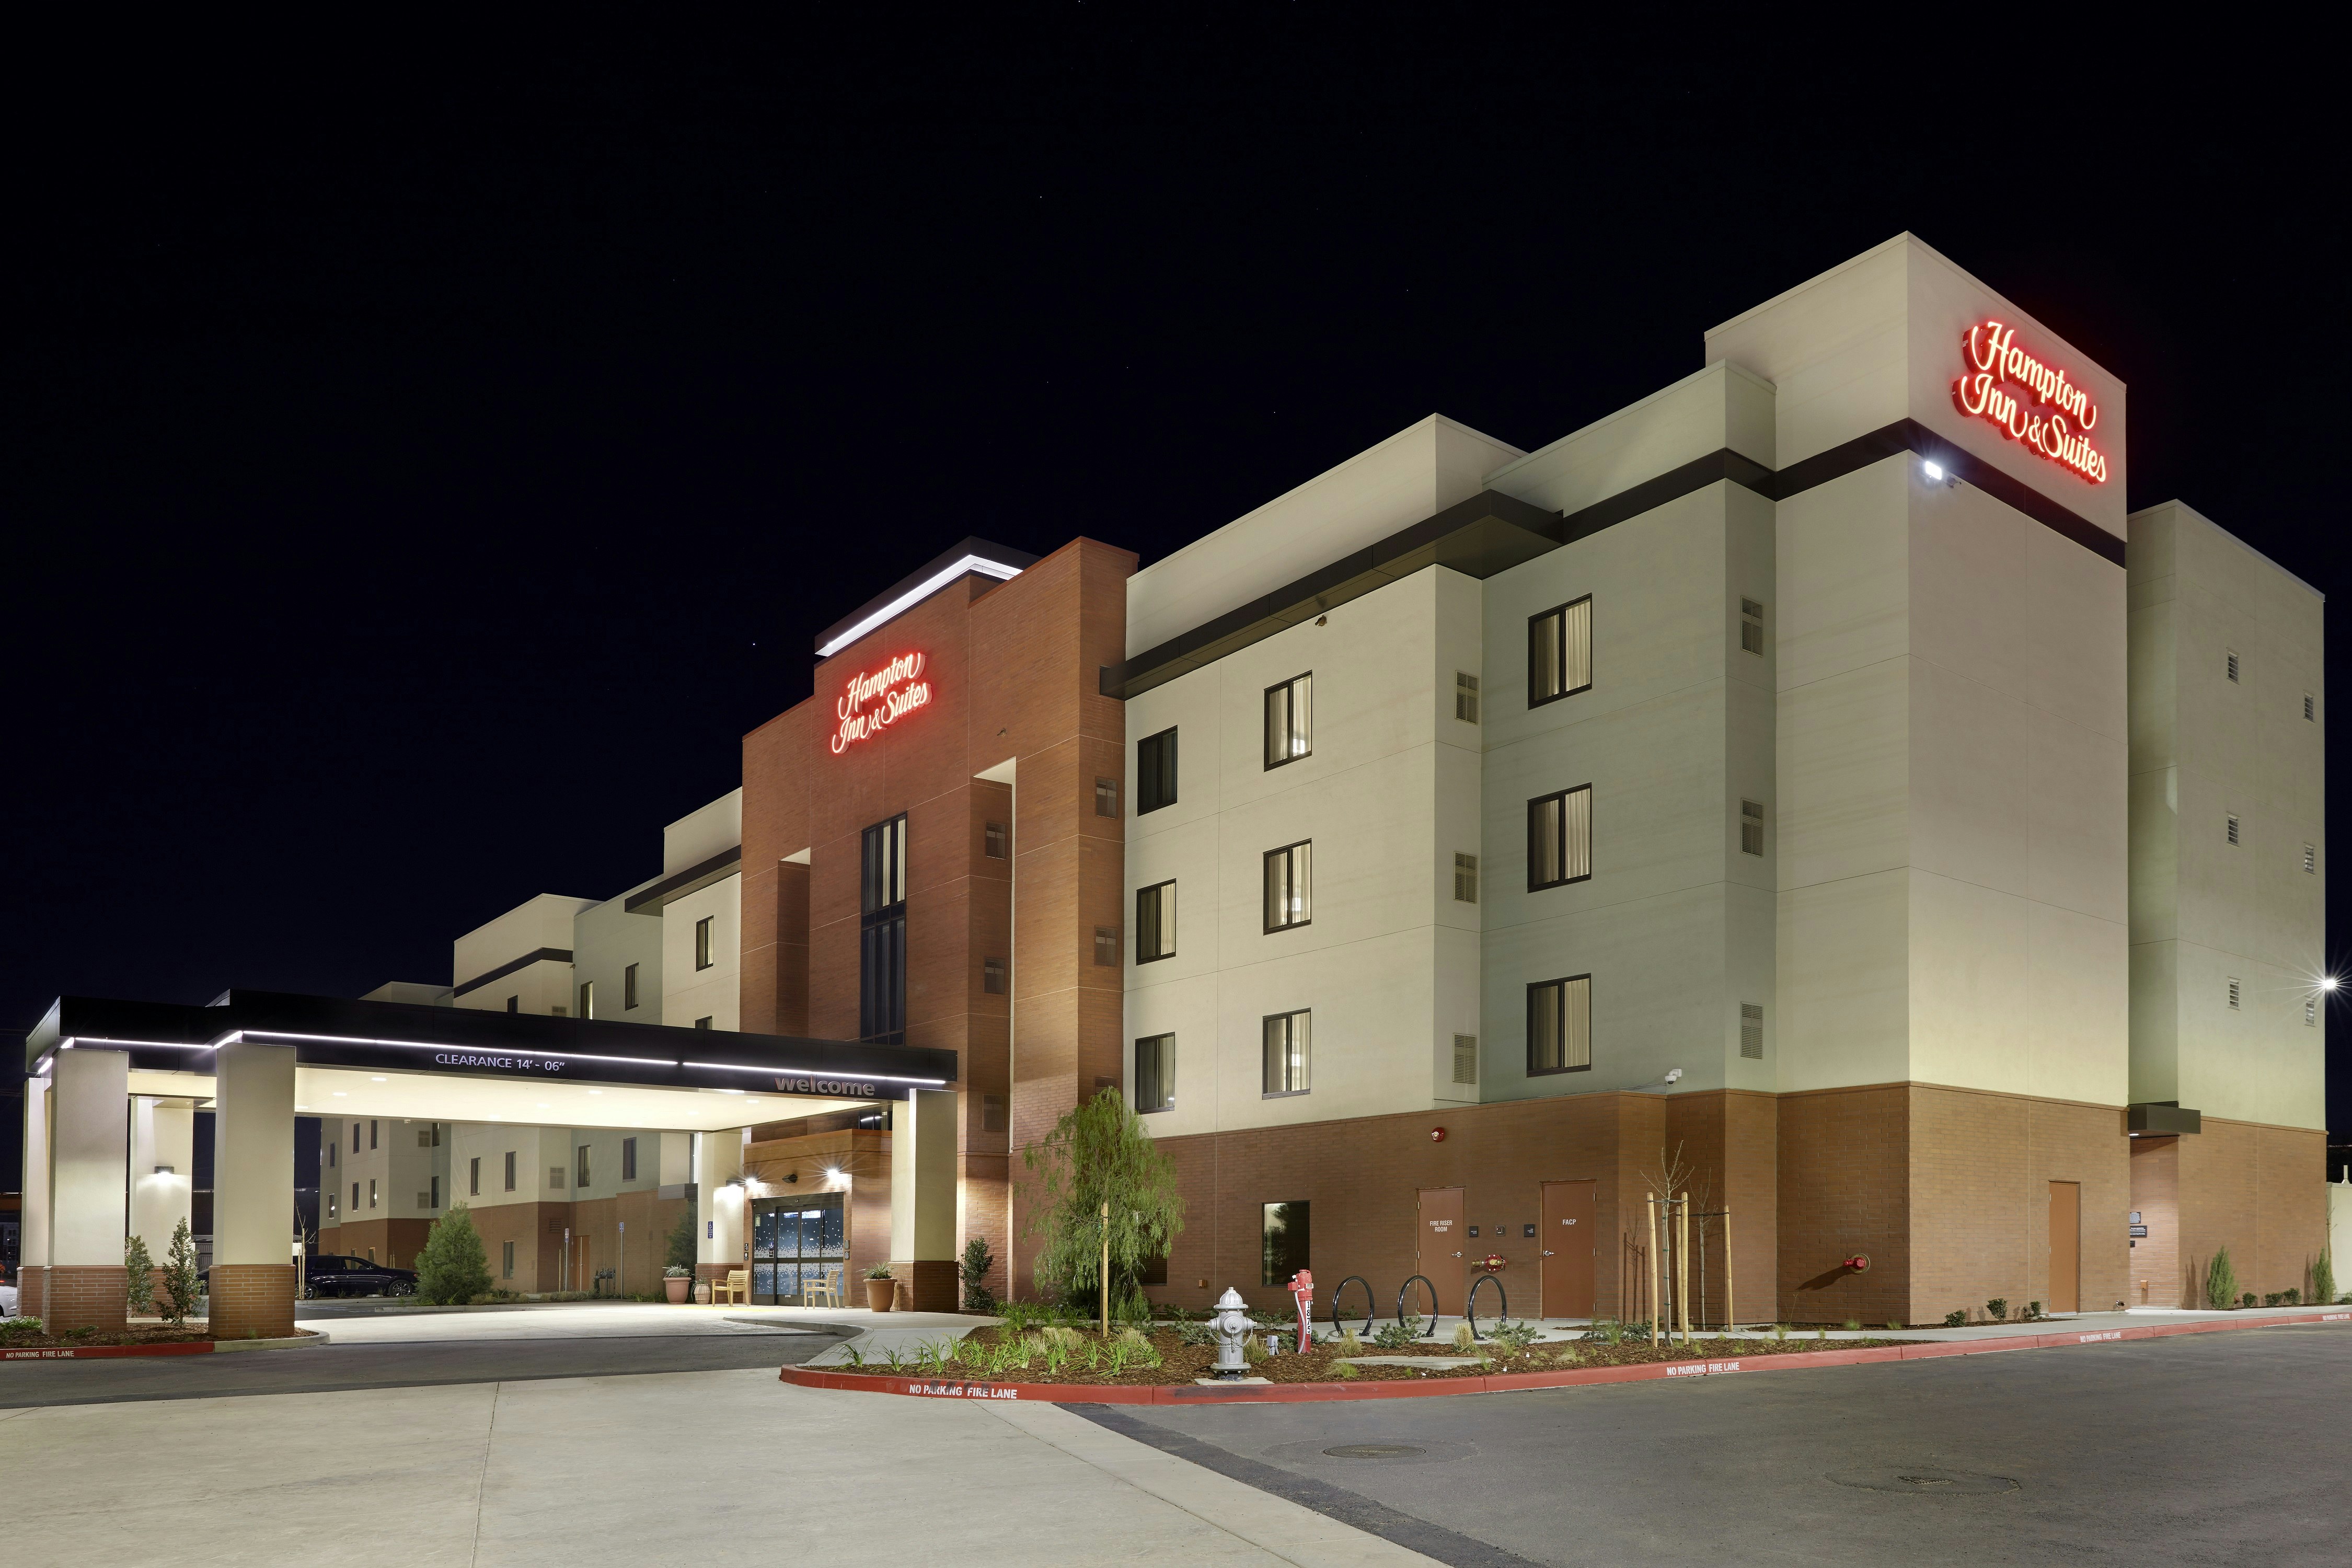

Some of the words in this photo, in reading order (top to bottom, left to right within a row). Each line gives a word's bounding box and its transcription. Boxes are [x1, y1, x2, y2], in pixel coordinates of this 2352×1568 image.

[1971, 321, 2096, 430] Hampton
[1960, 373, 2028, 437] Inn
[2028, 416, 2045, 453] &
[2043, 414, 2106, 482] Suites
[838, 652, 920, 720] Hampton
[832, 714, 871, 753] Inn
[871, 708, 883, 730] &
[881, 682, 928, 724] Suites
[435, 1053, 512, 1068] CLEARANCE
[775, 1074, 875, 1096] welcome
[909, 1384, 921, 1394] NO
[923, 1385, 962, 1396] PARKING
[967, 1387, 988, 1397] FIRE
[991, 1388, 1017, 1399] LANE
[1666, 1367, 1677, 1376] NO
[1678, 1364, 1707, 1375] PARKING
[1709, 1363, 1723, 1373] FIRE
[1724, 1362, 1739, 1371] LANE
